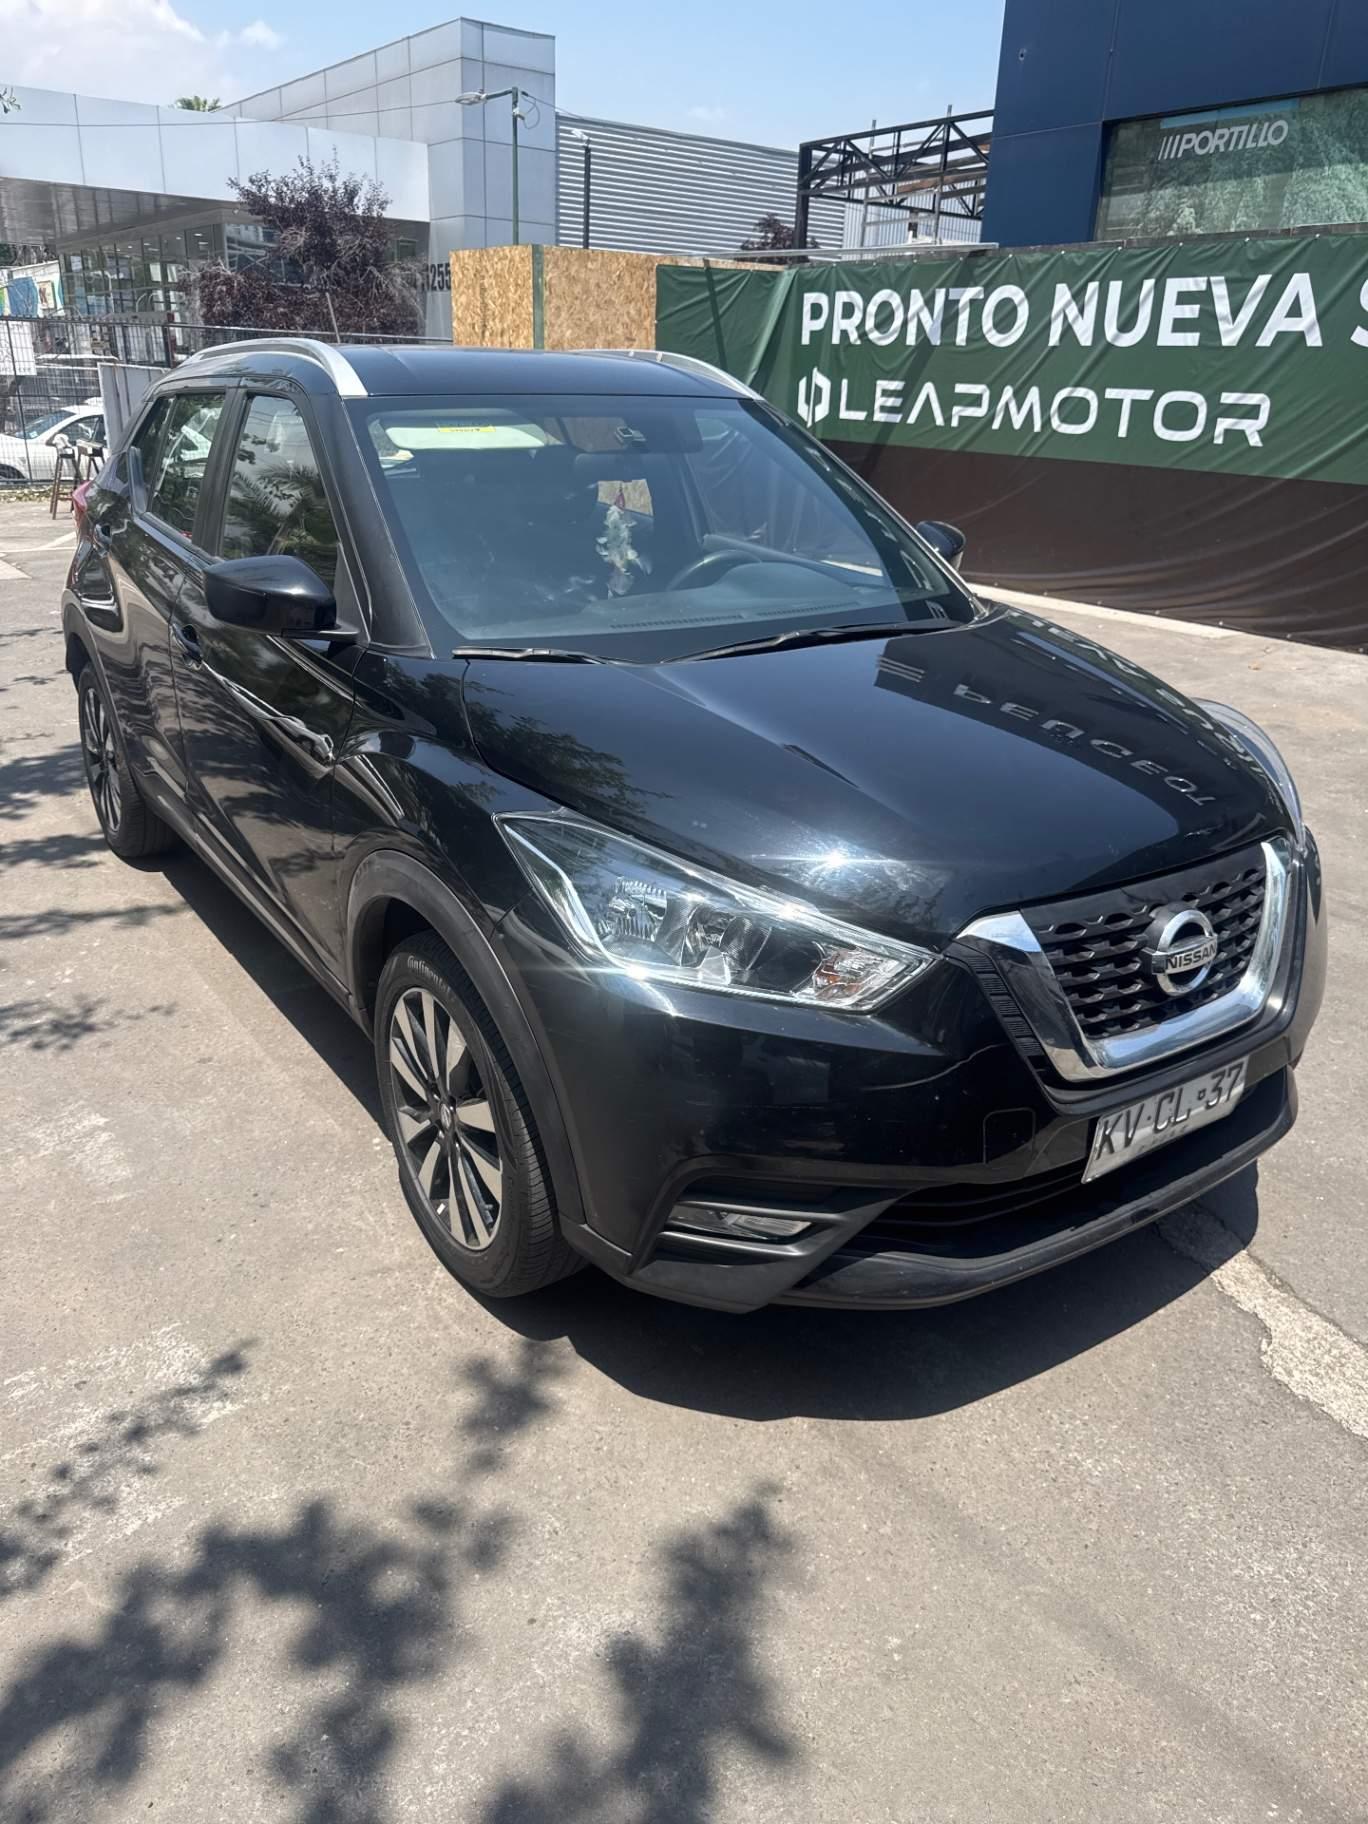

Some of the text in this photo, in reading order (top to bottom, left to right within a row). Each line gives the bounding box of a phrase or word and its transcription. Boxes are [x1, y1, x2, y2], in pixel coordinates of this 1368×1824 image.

[1177, 119, 1289, 158] PORTILLO
[800, 283, 1030, 348] PRONTO
[1047, 272, 1323, 348] NUEVA
[837, 376, 1272, 448] LEAPMOTOR
[1166, 942, 1217, 970] NISSAN
